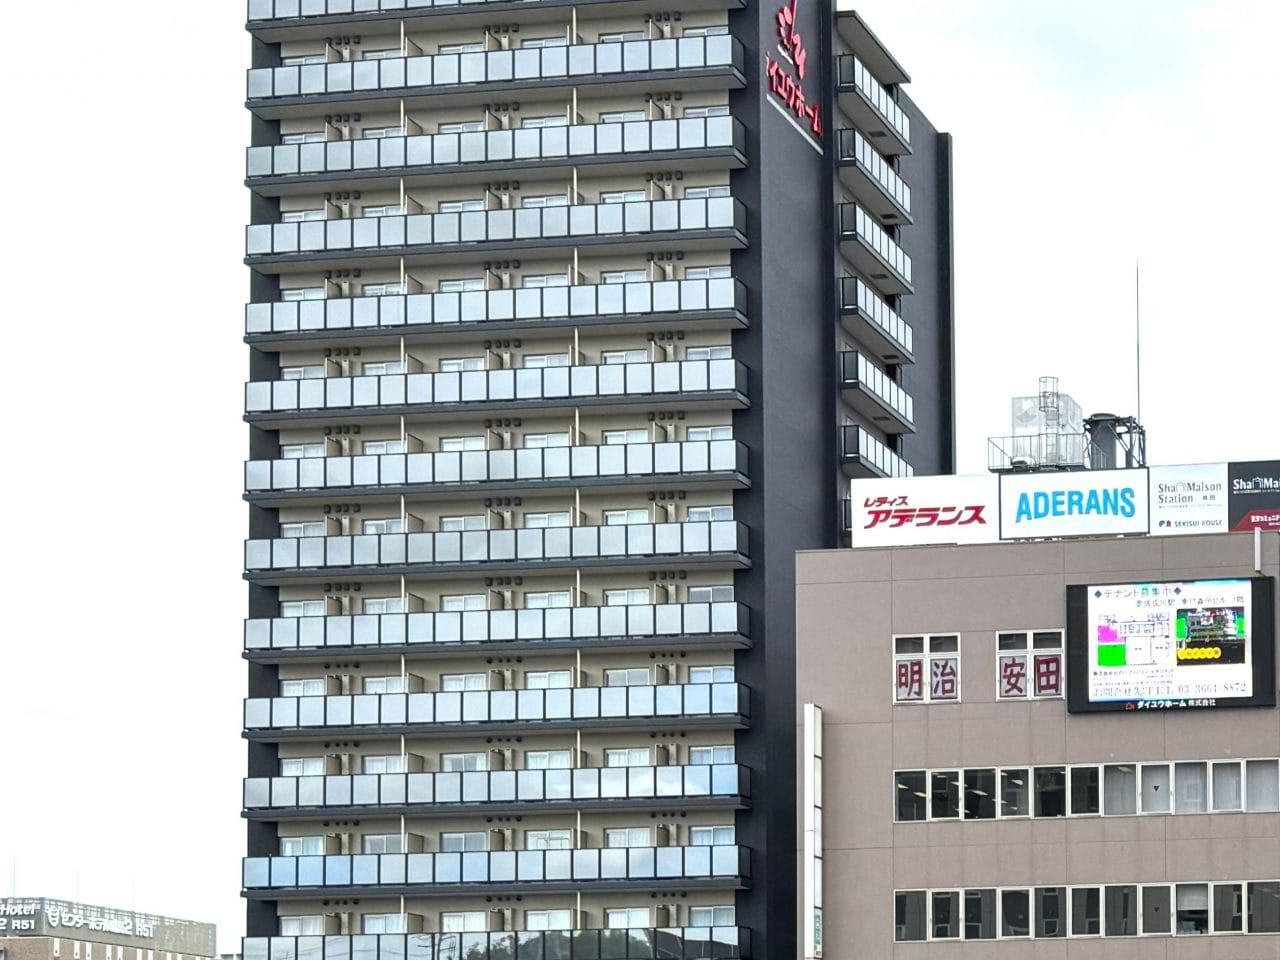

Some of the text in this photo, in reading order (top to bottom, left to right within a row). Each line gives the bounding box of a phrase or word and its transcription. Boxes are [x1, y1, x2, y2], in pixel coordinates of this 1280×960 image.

[766, 50, 822, 136] イユウホーム
[1186, 482, 1222, 492] Maison
[1015, 487, 1136, 523] ADERANS
[1158, 494, 1193, 503] Station
[864, 505, 987, 529] アデランス
[897, 656, 1062, 698] 明治 安田
[1137, 701, 1187, 709] ダイユウホーム
[0, 903, 35, 916] Hotel
